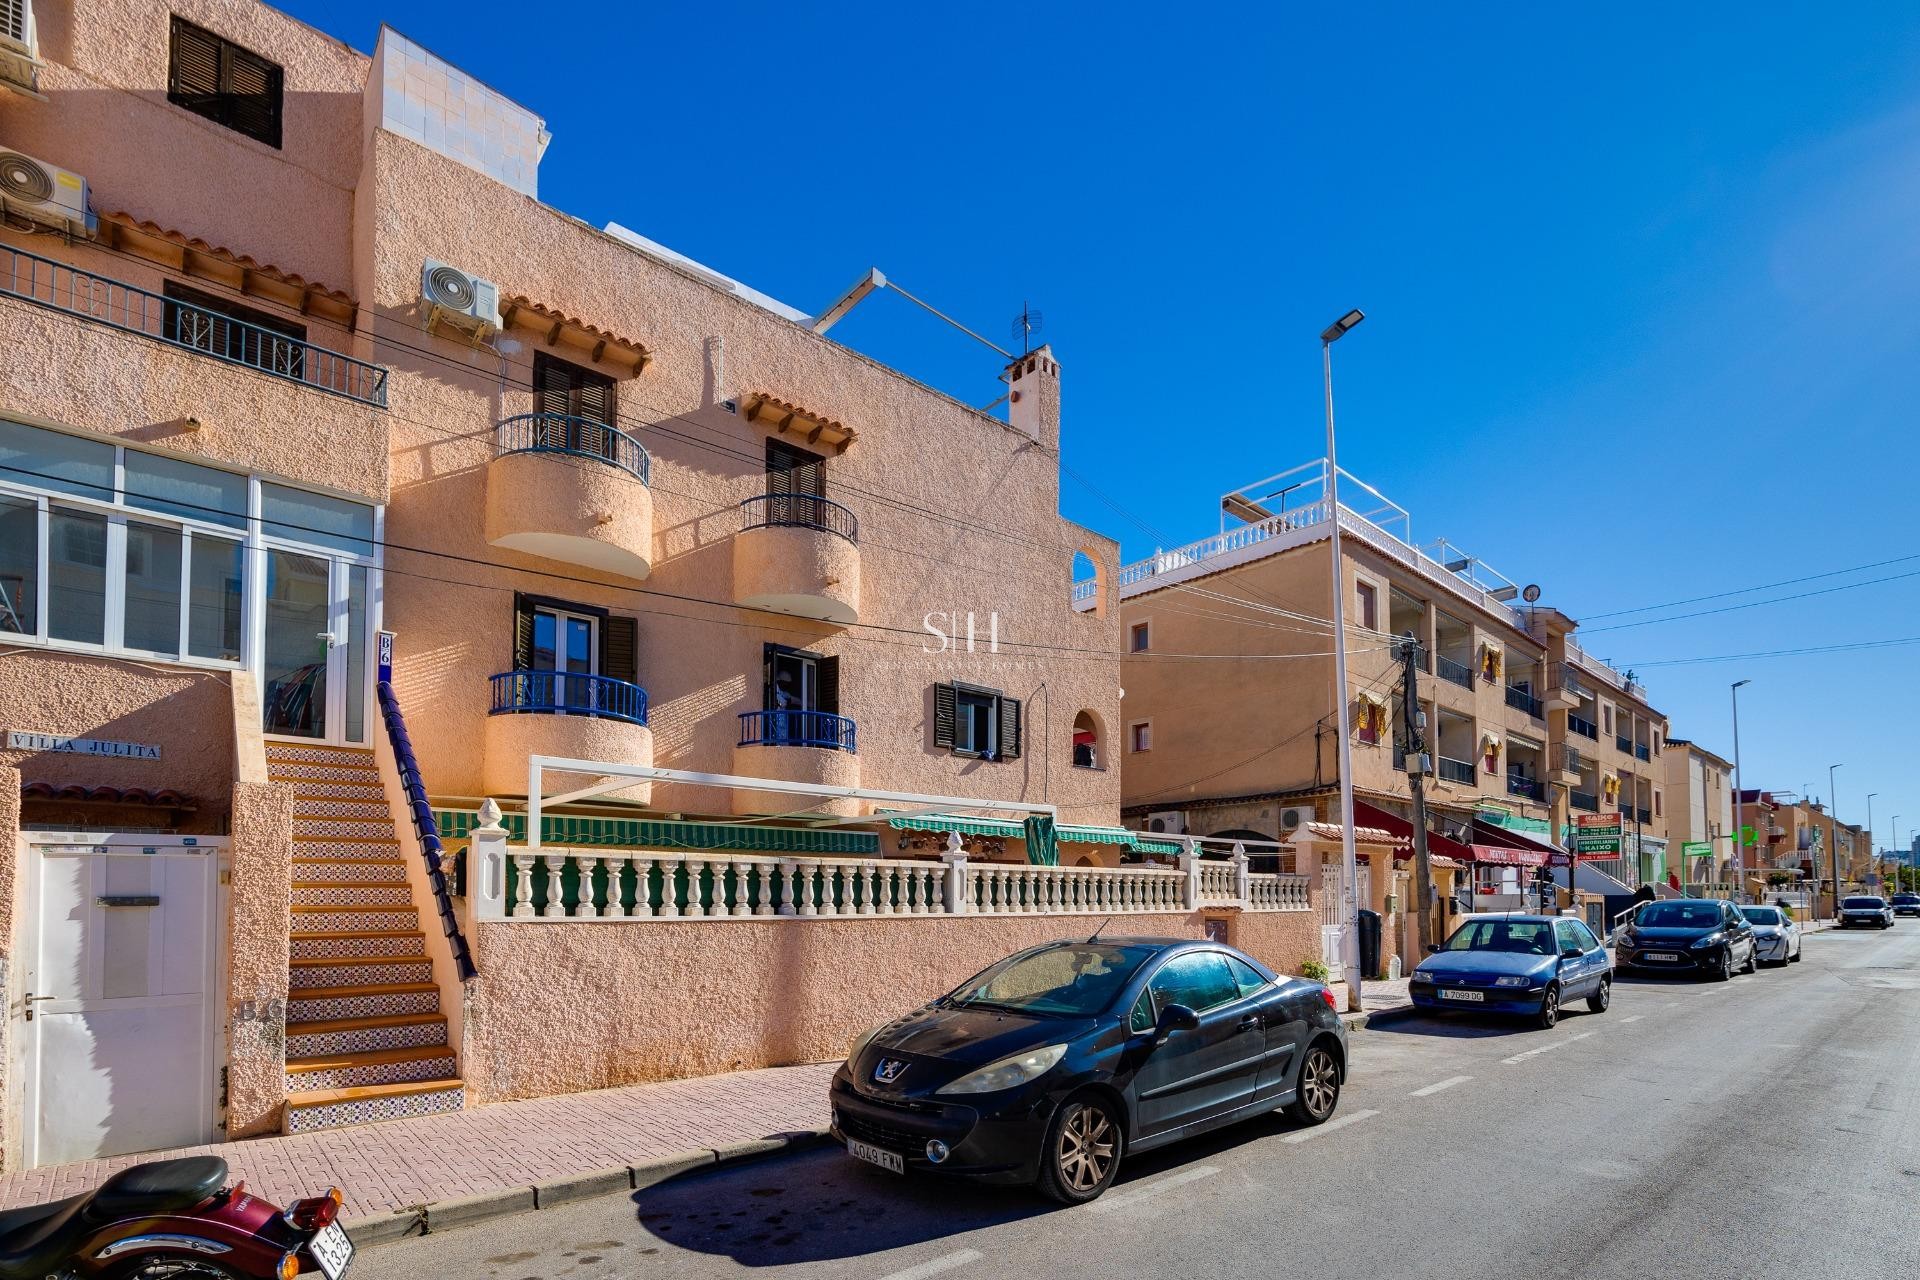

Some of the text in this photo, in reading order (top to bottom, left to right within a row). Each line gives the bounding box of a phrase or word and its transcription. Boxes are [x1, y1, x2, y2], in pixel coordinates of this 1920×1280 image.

[382, 637, 390, 648] B
[381, 652, 390, 663] 6
[13, 734, 157, 758] VILLA JULITA
[1450, 991, 1470, 1000] 7099
[852, 1143, 878, 1163] 4049
[327, 1234, 350, 1272] 1325
